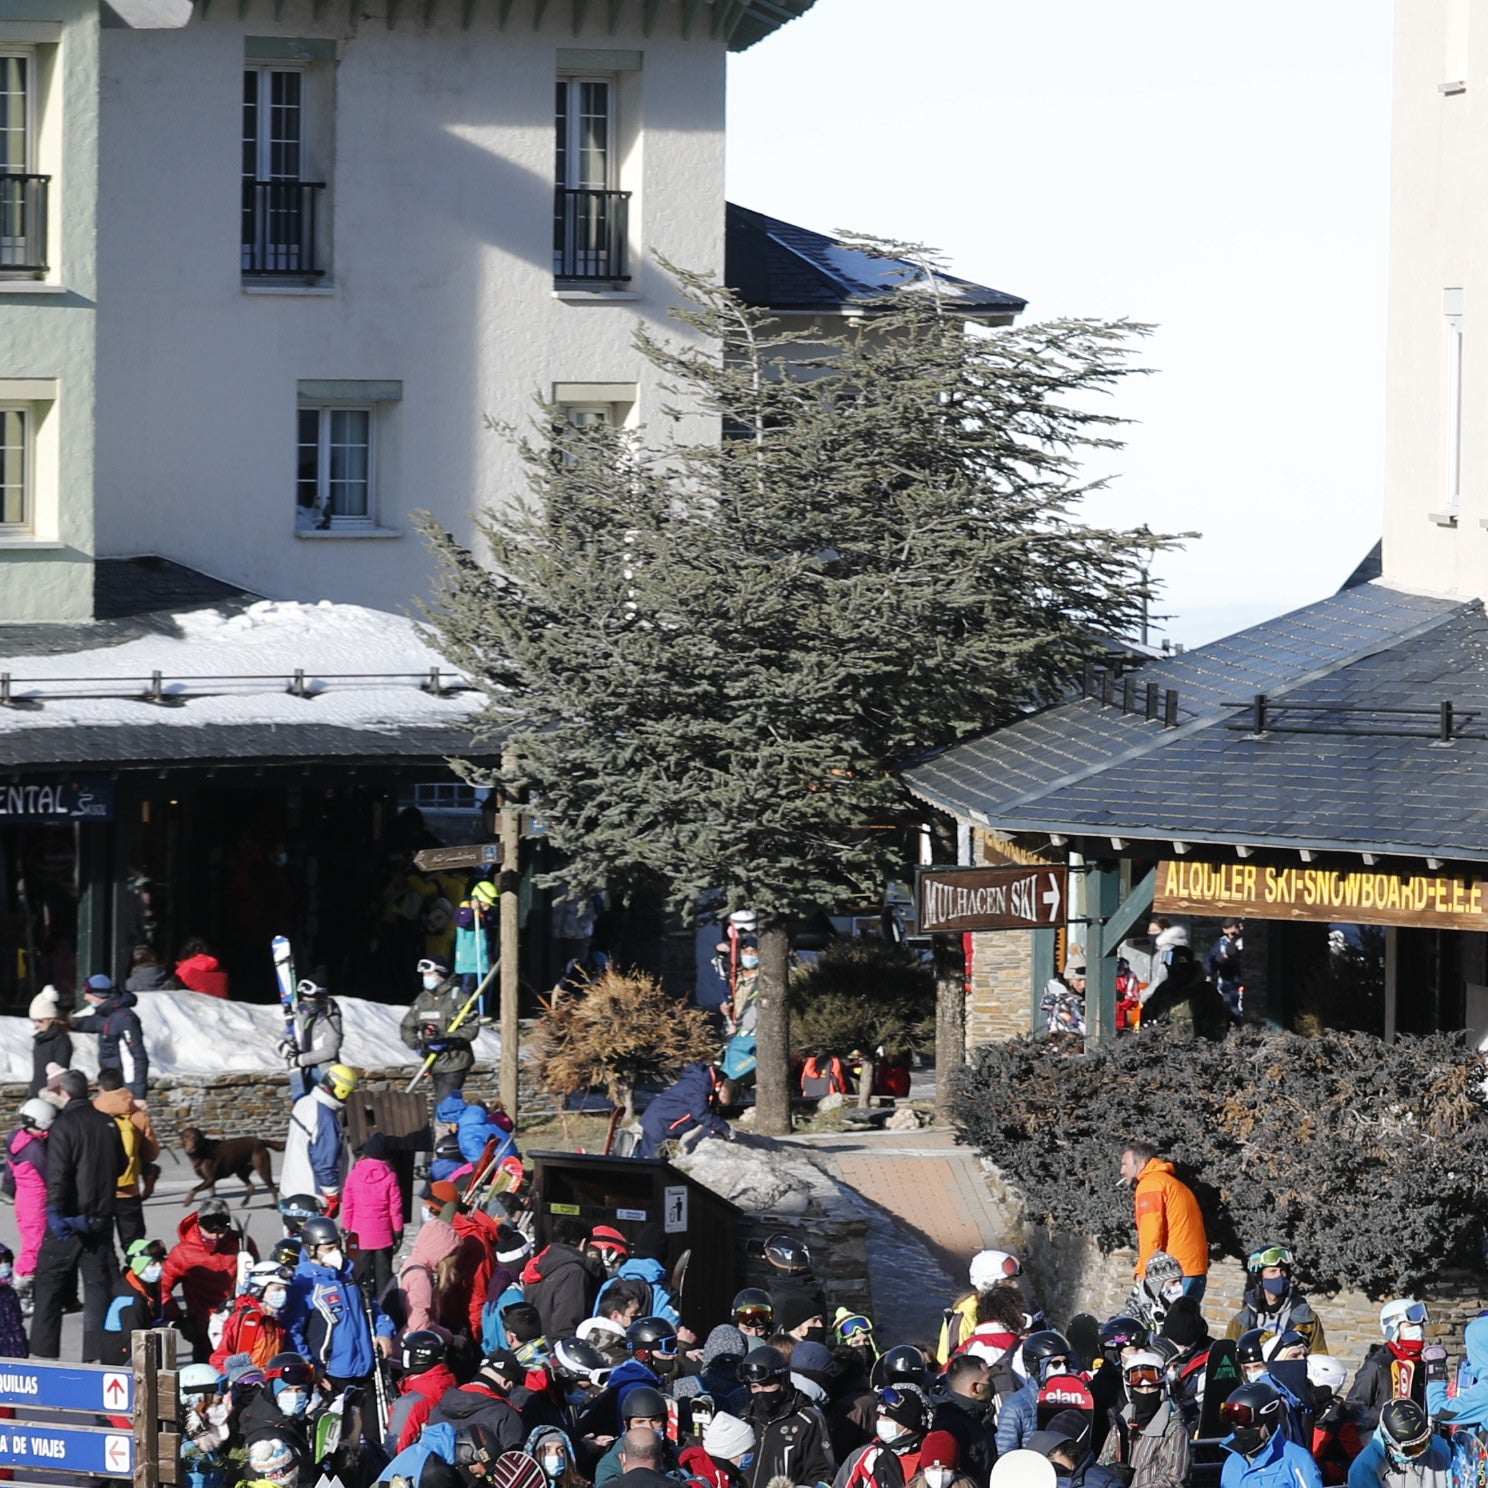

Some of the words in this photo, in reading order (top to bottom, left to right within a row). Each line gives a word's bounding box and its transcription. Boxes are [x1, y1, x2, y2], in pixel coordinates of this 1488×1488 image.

[924, 878, 1006, 929] MULHACEN
[1011, 874, 1038, 922] SKI
[1164, 860, 1257, 902] ALQUILER
[12, 1436, 27, 1452] DE
[31, 1437, 66, 1459] VIAJES
